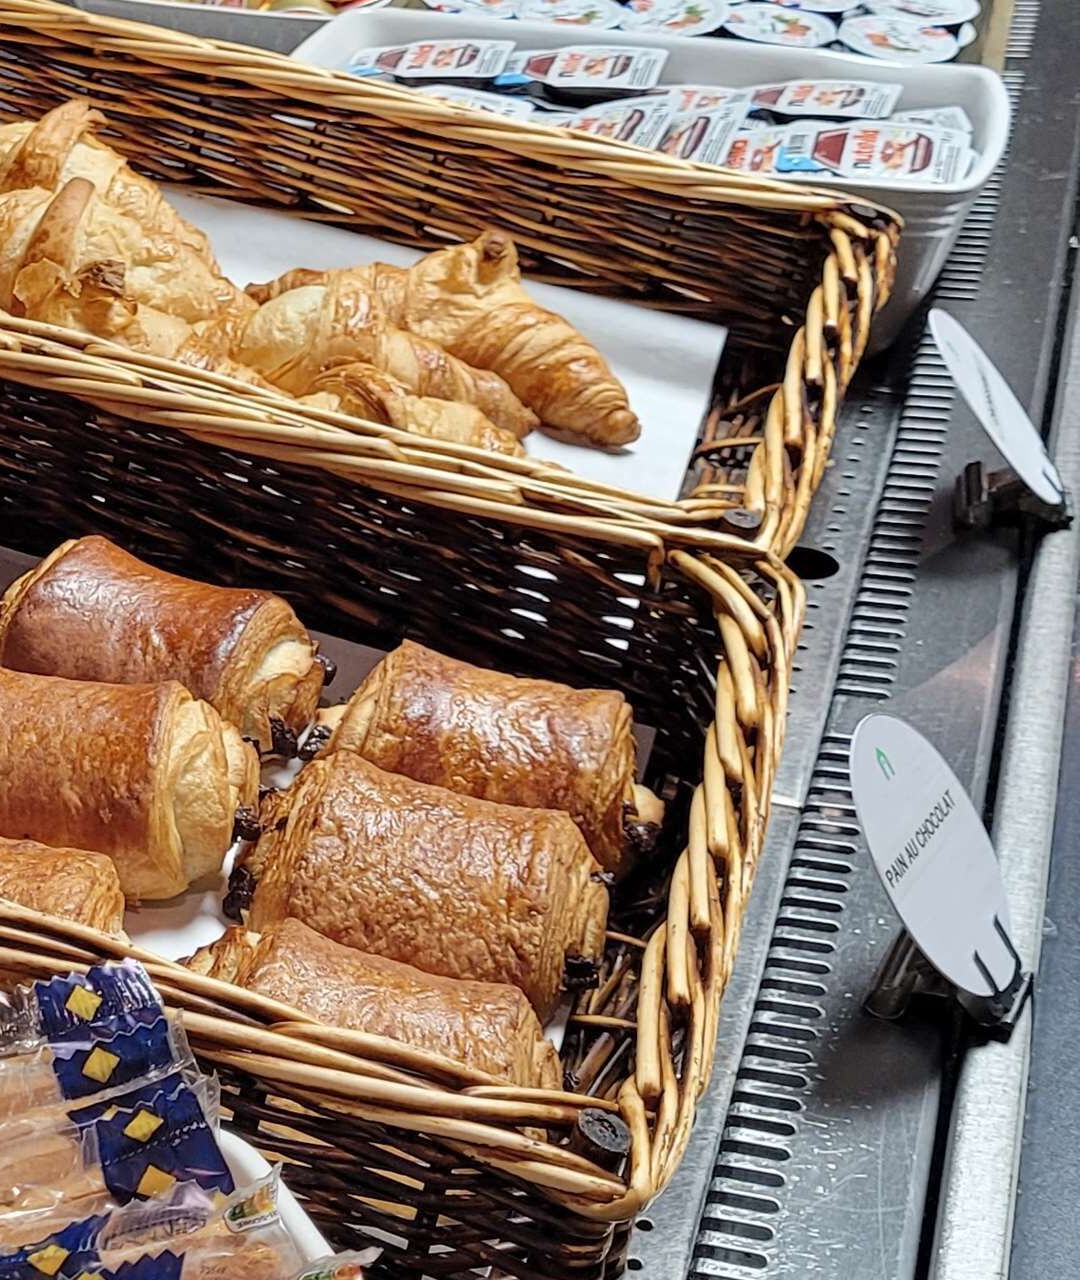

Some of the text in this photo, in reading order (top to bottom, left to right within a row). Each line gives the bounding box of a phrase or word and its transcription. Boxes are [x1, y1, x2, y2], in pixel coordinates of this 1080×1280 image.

[884, 788, 957, 889] PAIN AU CHOCOLAT
